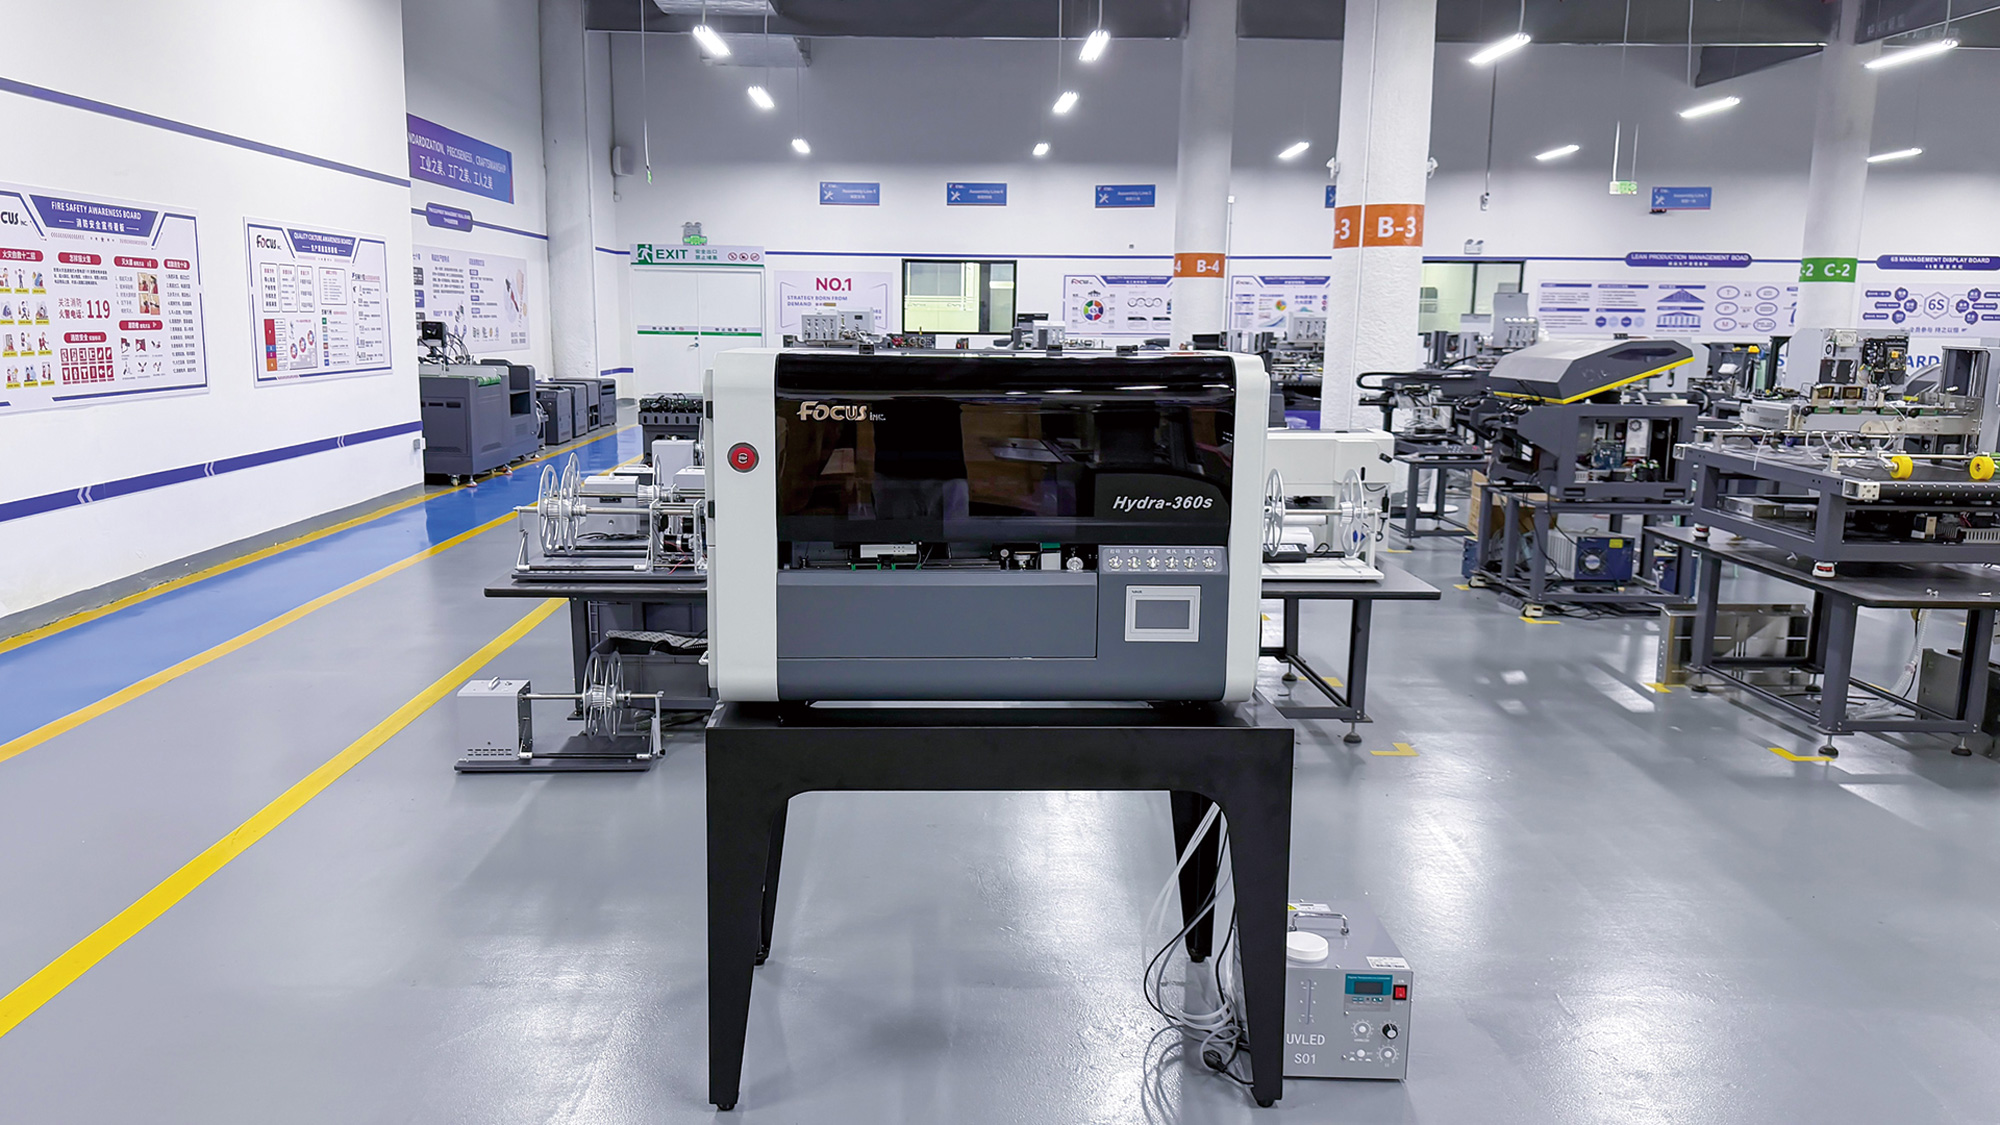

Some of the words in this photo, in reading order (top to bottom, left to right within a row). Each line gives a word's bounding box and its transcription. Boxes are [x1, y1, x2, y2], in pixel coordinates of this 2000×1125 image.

[51, 201, 64, 211] FIRE
[65, 203, 87, 214] SAFETY
[88, 206, 122, 218] AWARENESS
[123, 210, 142, 220] BOARD
[1377, 216, 1416, 238] B-3
[656, 249, 688, 259] EXIT
[1196, 260, 1220, 273] B-4
[1824, 263, 1850, 277] C-2
[816, 278, 852, 291] NO.1
[58, 298, 82, 307] 关注消防
[1929, 299, 1944, 310] 6S
[87, 300, 110, 319] 119
[796, 401, 867, 420] FOCUS
[1112, 496, 1213, 512] Hydra-360s
[1286, 1033, 1325, 1045] UVLED
[1294, 1053, 1316, 1064] S01
